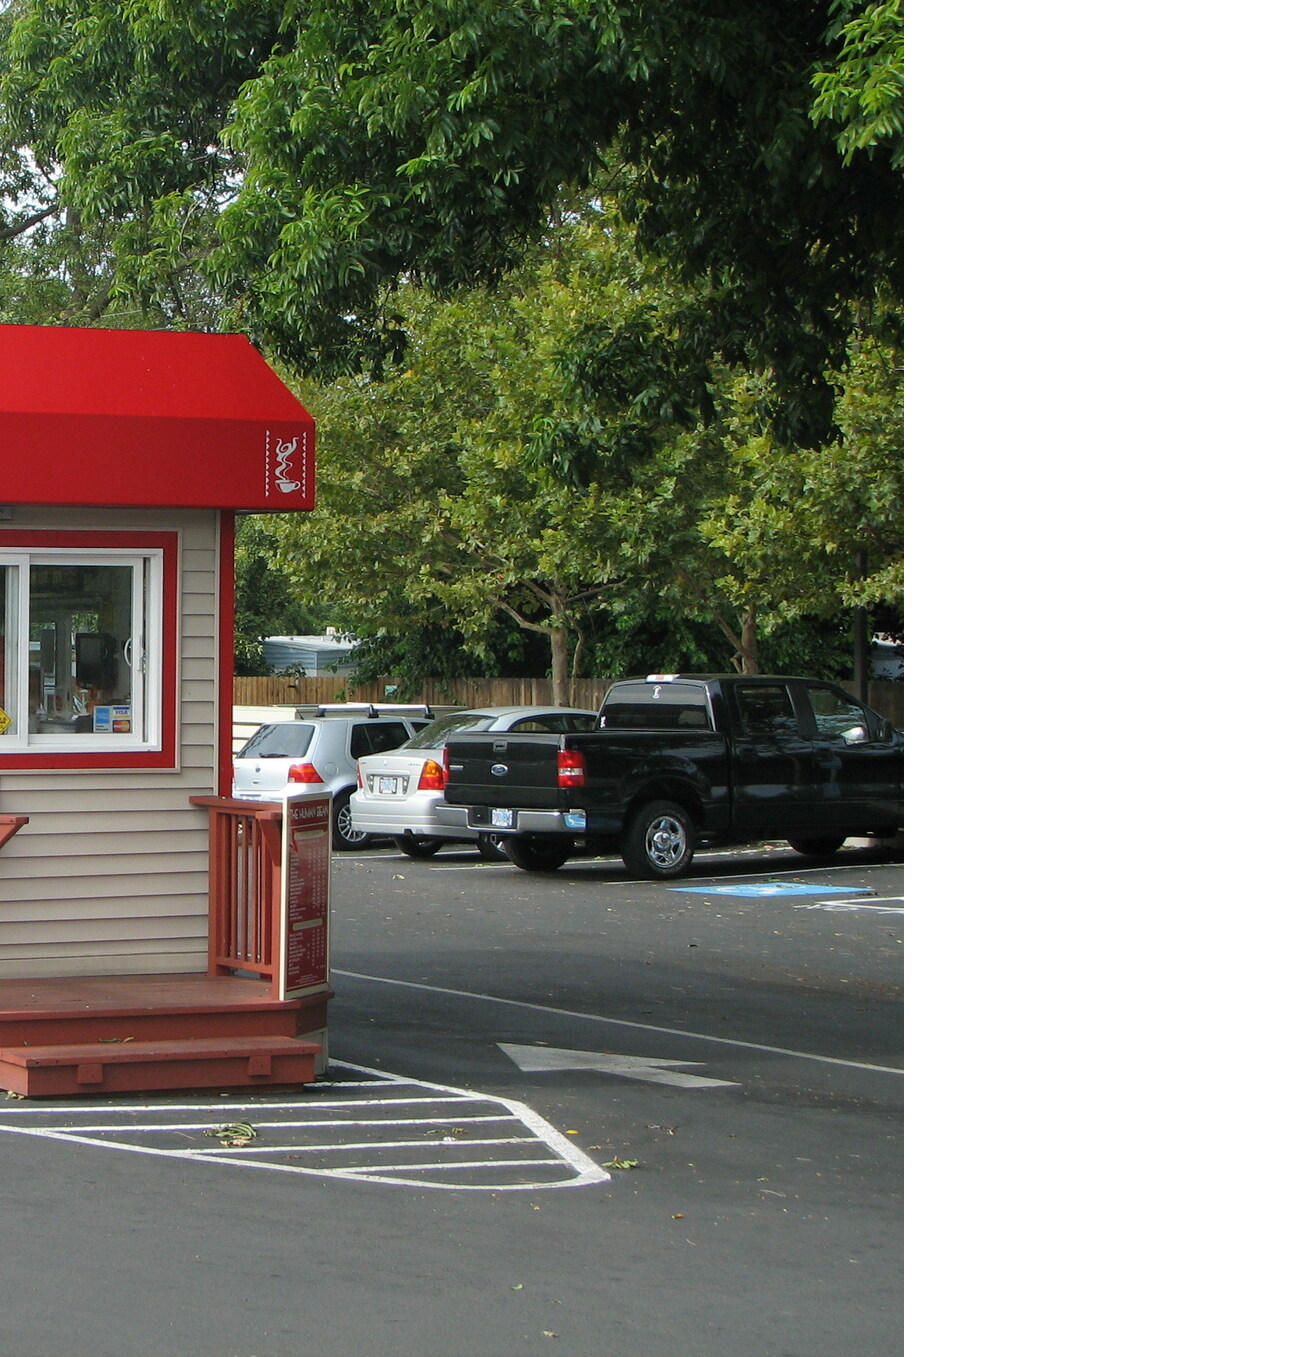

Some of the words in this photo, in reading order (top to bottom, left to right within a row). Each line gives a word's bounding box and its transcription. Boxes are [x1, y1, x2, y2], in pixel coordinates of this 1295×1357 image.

[289, 808, 298, 820] THE
[299, 807, 316, 819] HUMAN
[317, 805, 329, 817] BEAN
